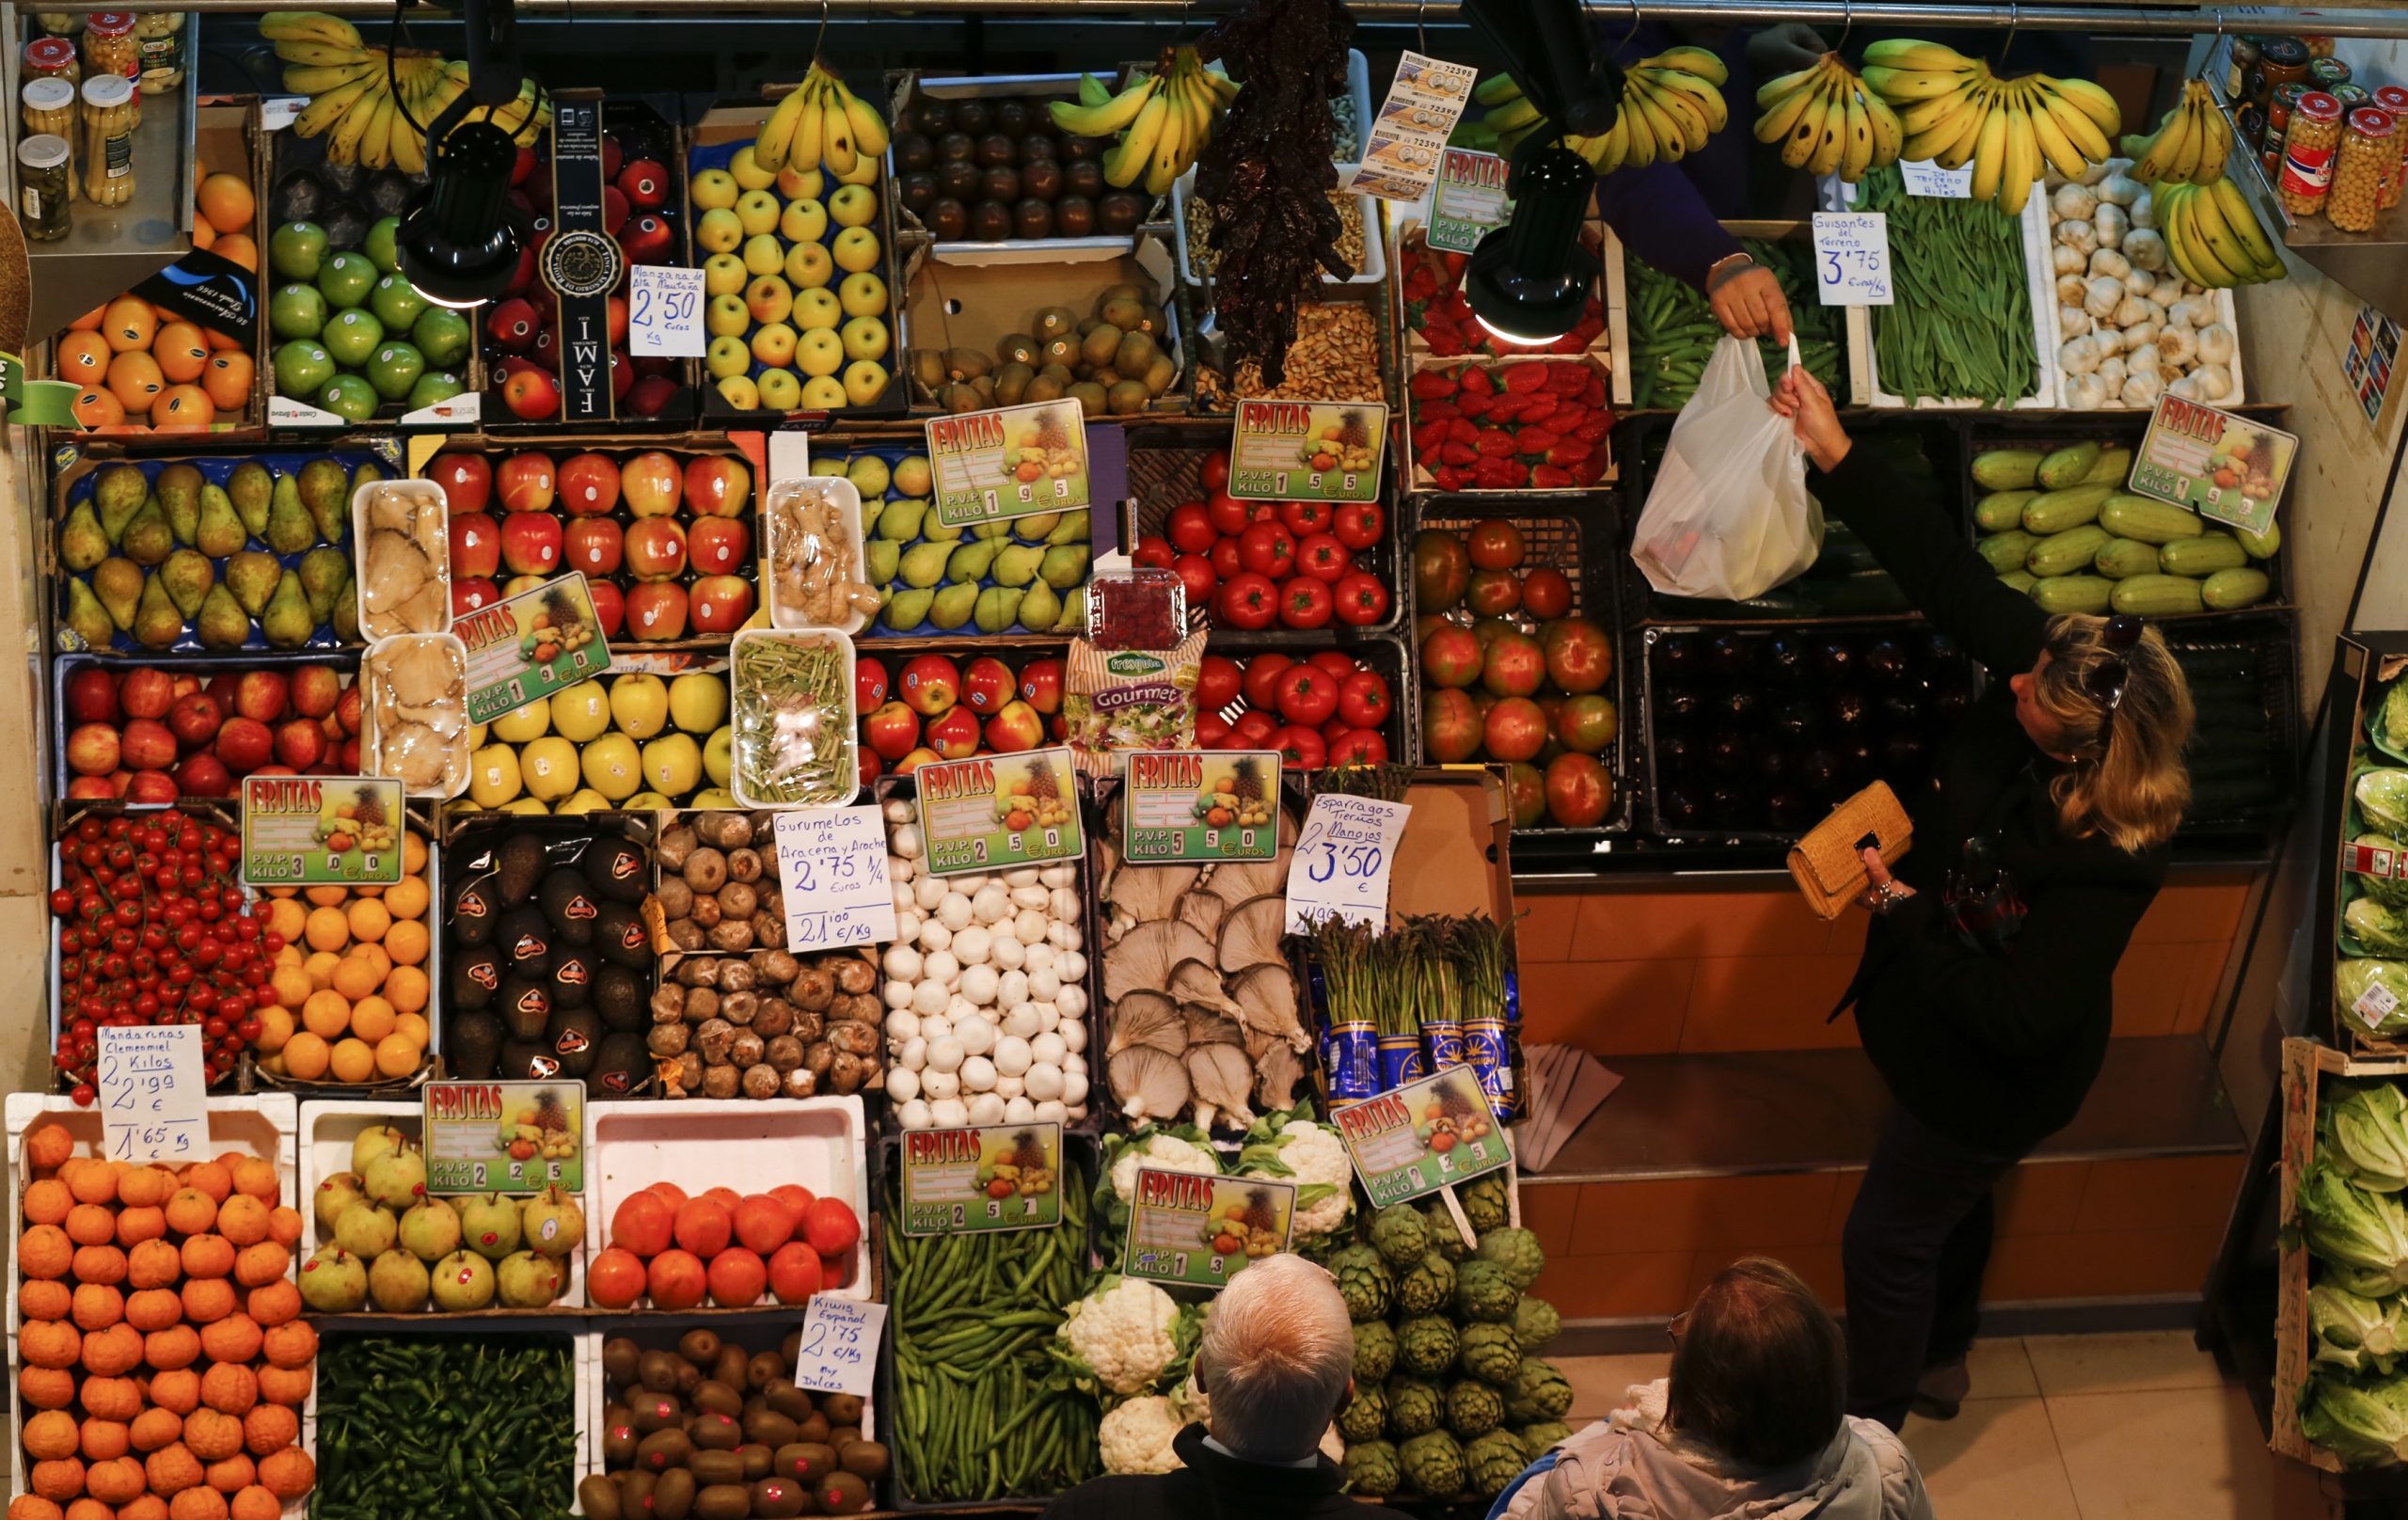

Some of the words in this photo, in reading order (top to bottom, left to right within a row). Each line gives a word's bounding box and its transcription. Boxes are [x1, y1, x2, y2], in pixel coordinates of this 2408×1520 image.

[1444, 65, 1473, 77] 72398
[1461, 80, 1470, 95] ONCE
[1414, 138, 1441, 150] 72398
[1431, 152, 1439, 168] ONCE
[1913, 175, 1962, 185] Terreno
[1925, 187, 1957, 197] Hilos
[1814, 215, 1875, 229] Guisantes
[1436, 232, 1469, 245] KILO
[1838, 228, 1853, 237] del
[1819, 237, 1861, 247] Terreno
[633, 266, 689, 280] Manzana
[693, 271, 703, 280] de
[1822, 250, 1880, 285] 3'75
[632, 289, 696, 326] 2'50
[1242, 403, 1312, 435] FRUTAS
[2158, 396, 2227, 445] FRUTAS
[932, 413, 1006, 454] FRUTAS
[1239, 470, 1273, 481] P.V.P.
[2144, 465, 2175, 482] P.V.P.
[1238, 483, 1271, 493] KILO
[1277, 475, 1286, 492] 1
[1347, 476, 1354, 488] 5
[2139, 475, 2172, 495] KILO
[946, 492, 981, 506] P.V.P.
[988, 493, 997, 512] 1
[1056, 483, 1064, 496] 5
[948, 505, 983, 519] KILO
[452, 604, 517, 653] RUTAS
[511, 683, 520, 700] 1
[575, 654, 584, 667] 0
[471, 685, 506, 705] P.V.P.
[1096, 685, 1177, 708] Gourmet
[475, 696, 510, 718] KILO
[1133, 754, 1203, 789] FRUTAS
[922, 760, 996, 801] FRUTAS
[249, 780, 323, 814] FRUTAS
[1316, 796, 1395, 817] Esparragos
[1331, 810, 1383, 826] Tiernos
[817, 831, 833, 843] de
[1134, 831, 1169, 842] P.V.P.
[1173, 833, 1182, 851] 5
[1244, 831, 1252, 845] 0
[1297, 822, 1323, 854] 2
[1327, 821, 1382, 844] Manojos
[781, 845, 837, 859] Aracena
[842, 846, 848, 855] y
[851, 837, 886, 851] Aroche
[934, 840, 971, 853] P.V.P.
[975, 841, 985, 861] 2
[1048, 832, 1056, 845] 0
[1134, 844, 1168, 855] KILO
[252, 854, 289, 864] P.V.P.
[293, 858, 302, 875] 3
[370, 856, 377, 869] 0
[936, 853, 972, 867] KILO
[1309, 842, 1382, 882] 3'50
[252, 866, 288, 878] KILO
[795, 854, 855, 892] 2'75
[1358, 882, 1369, 893] €
[102, 1027, 185, 1039] Mandarinas
[102, 1055, 119, 1085] 2
[130, 1054, 173, 1070] Kilos
[111, 1074, 174, 1110] 2'99
[151, 1099, 163, 1111] €
[428, 1085, 503, 1120] FRUTAS
[1338, 1093, 1411, 1144] FRUTAS
[115, 1128, 167, 1160] 1'65
[175, 1133, 189, 1152] Kg
[908, 1129, 981, 1164] FRUTAS
[150, 1149, 159, 1159] €
[435, 1163, 470, 1173] P.V.P.
[475, 1166, 485, 1185] 2
[552, 1165, 561, 1178] 5
[435, 1176, 470, 1187] KILO
[1372, 1171, 1406, 1189] P.V.P.
[1139, 1171, 1214, 1212] FRUTAS
[1378, 1183, 1411, 1201] KILO
[911, 1204, 949, 1215] P.V.P.
[954, 1206, 963, 1225] 2
[911, 1216, 948, 1228] KILO
[1133, 1261, 1169, 1275] KILO
[1176, 1256, 1184, 1275] 1
[815, 1297, 854, 1313] Kiwis
[801, 1322, 863, 1357] 2'75
[802, 1375, 843, 1389] Dulces
